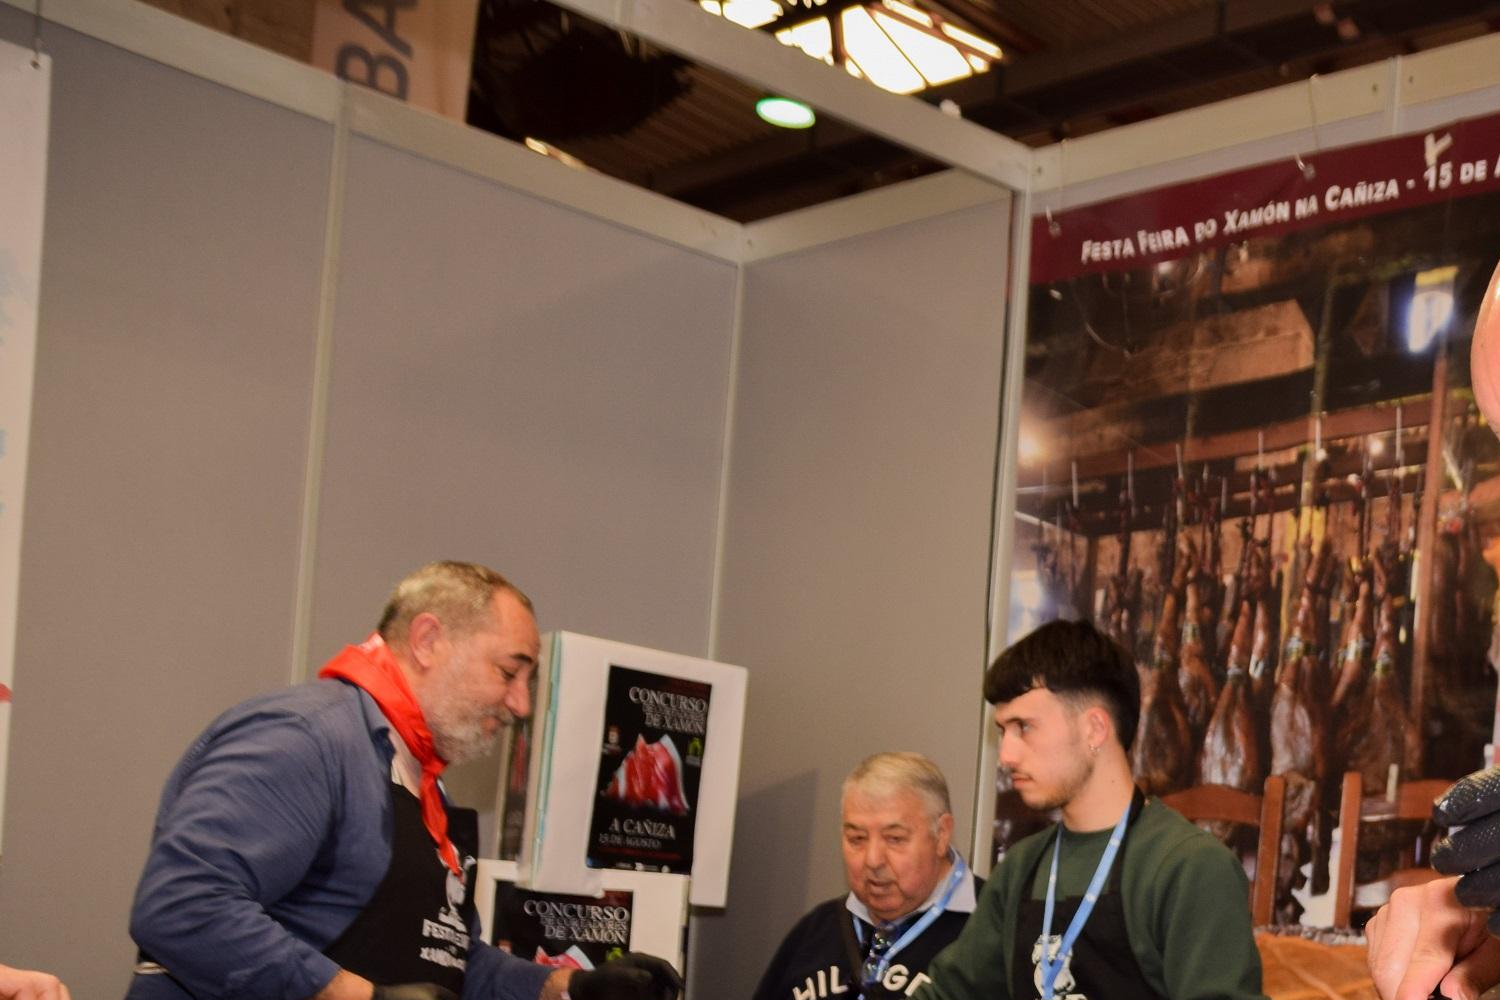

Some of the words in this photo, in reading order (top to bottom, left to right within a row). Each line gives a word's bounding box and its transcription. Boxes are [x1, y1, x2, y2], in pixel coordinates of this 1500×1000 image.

[1424, 161, 1453, 191] 15
[629, 686, 707, 713] CONCURSO
[609, 817, 620, 832] A
[623, 818, 675, 840] CAÑIZA
[523, 899, 630, 922] CONCURSO
[544, 924, 566, 938] DE
[570, 927, 627, 944] XAMÓN
